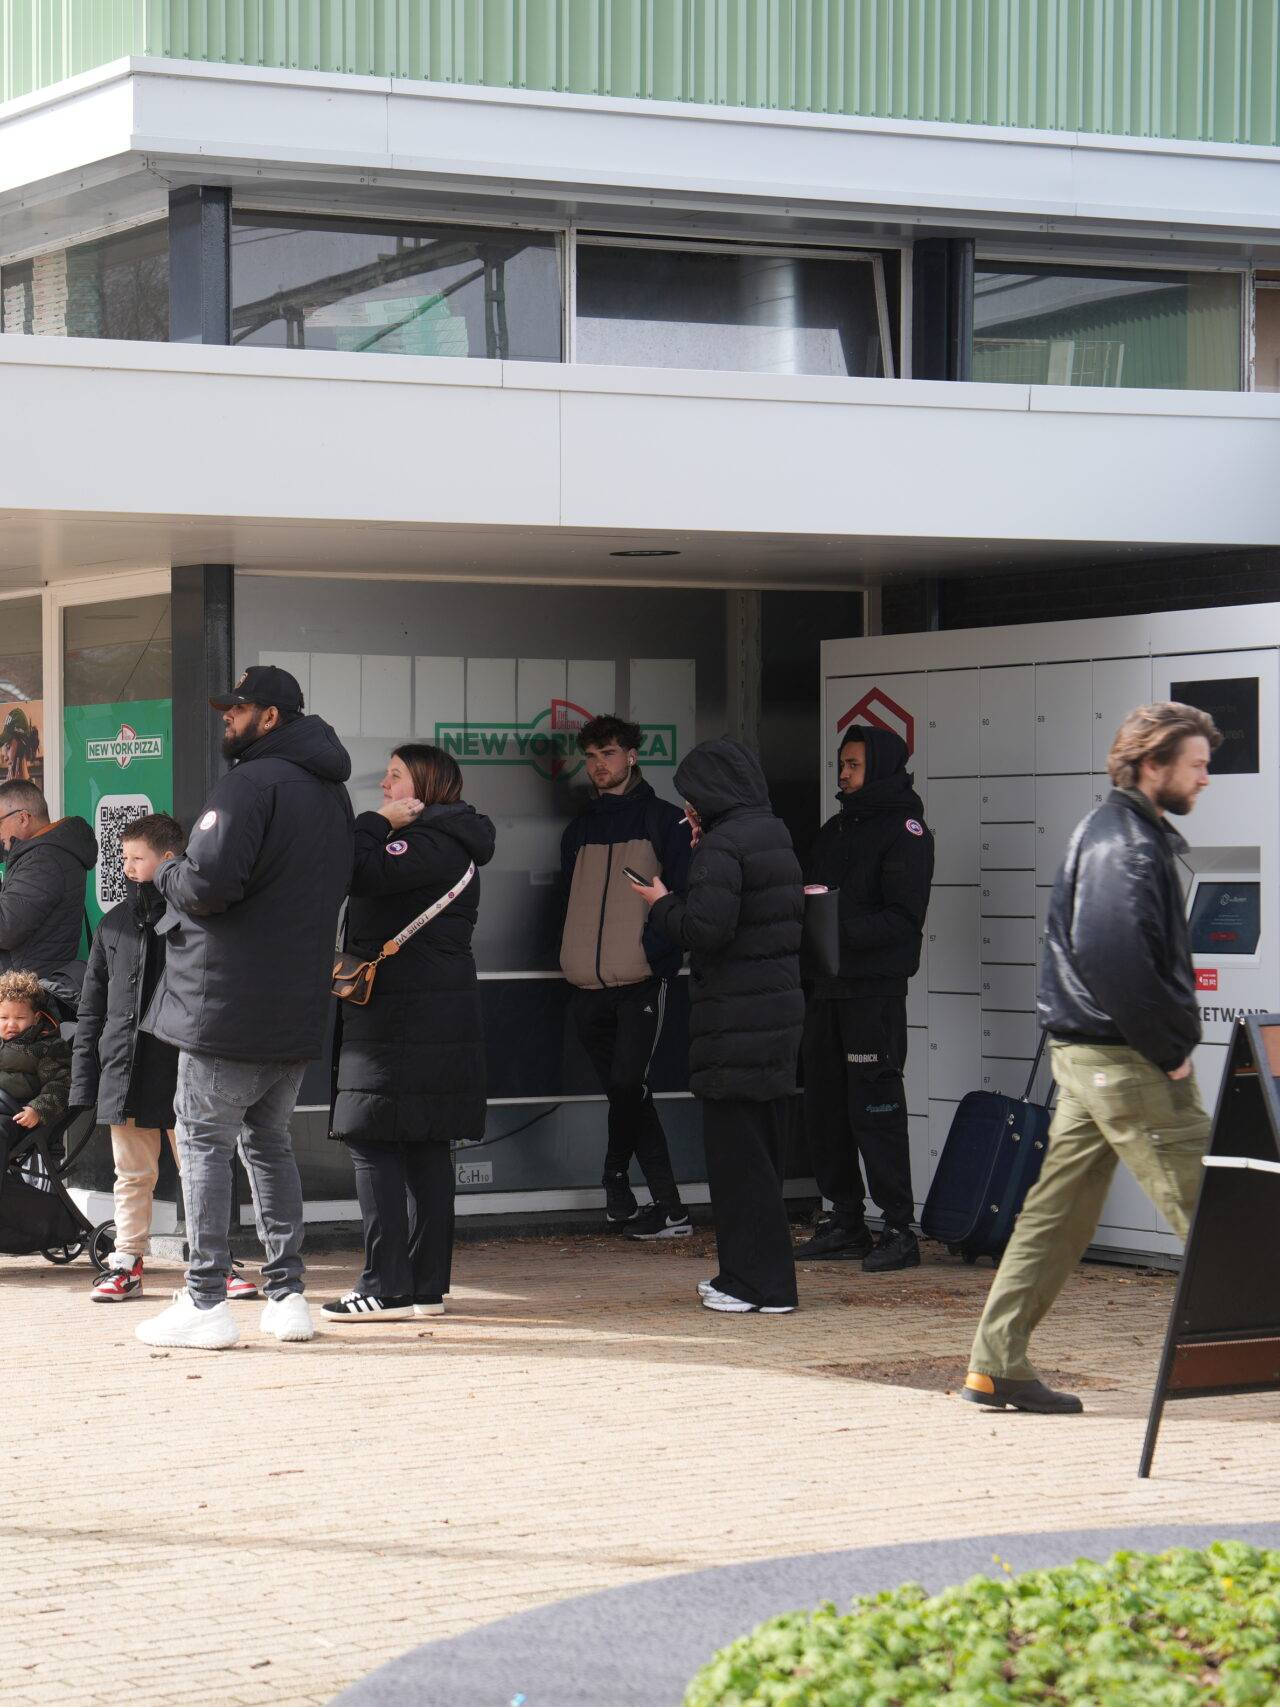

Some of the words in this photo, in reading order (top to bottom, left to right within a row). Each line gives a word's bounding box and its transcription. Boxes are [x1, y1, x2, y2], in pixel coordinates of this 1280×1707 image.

[89, 744, 109, 757] NEW
[110, 743, 133, 756] YORK
[134, 740, 160, 754] PIZZA
[443, 732, 508, 756] NEW
